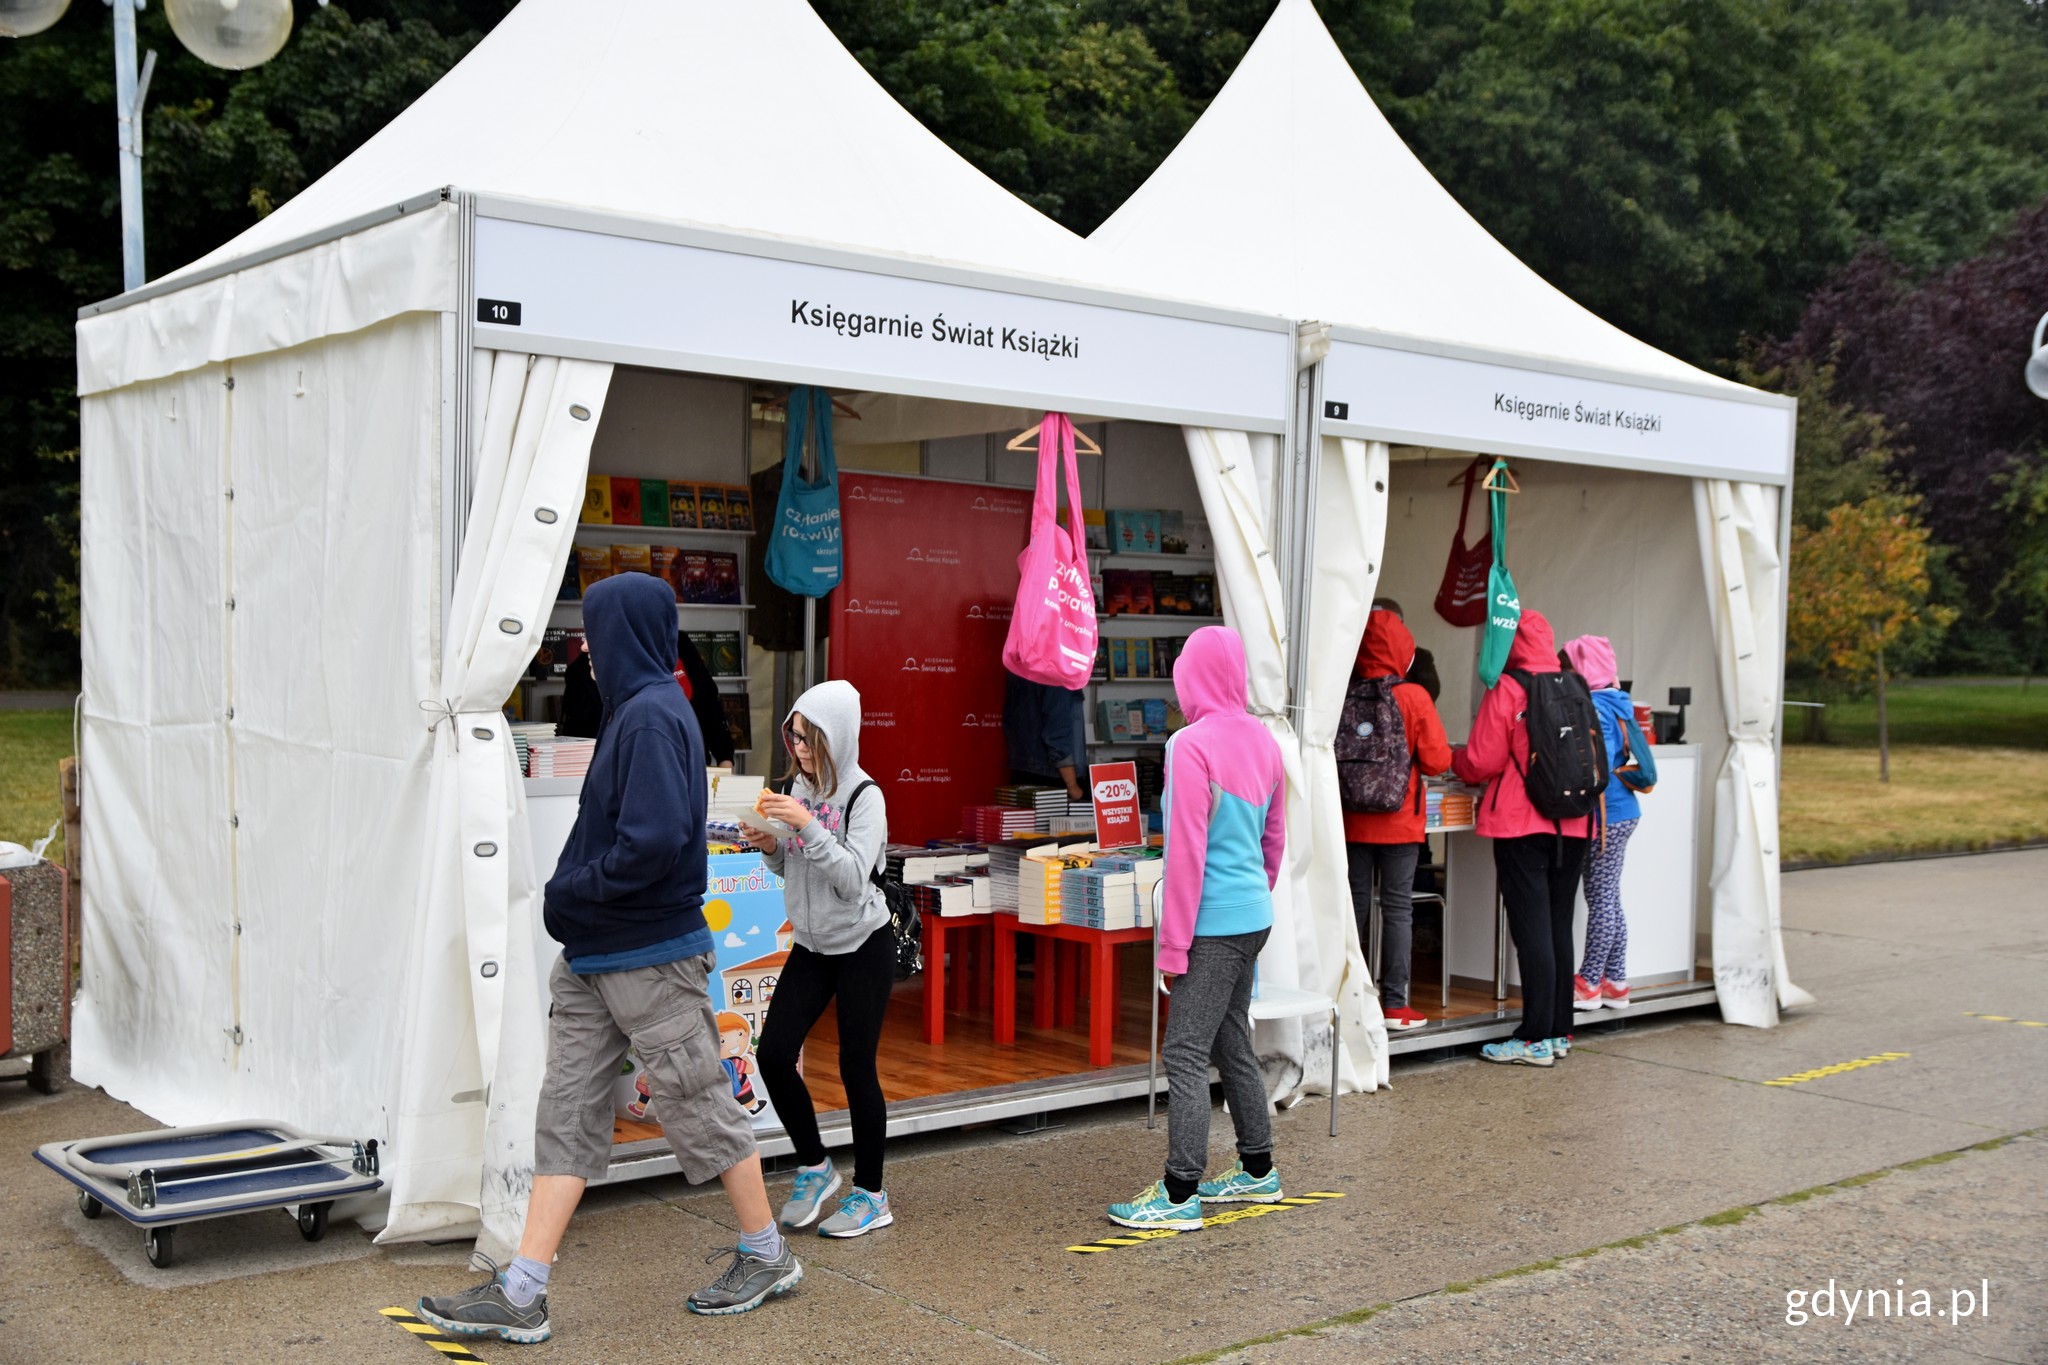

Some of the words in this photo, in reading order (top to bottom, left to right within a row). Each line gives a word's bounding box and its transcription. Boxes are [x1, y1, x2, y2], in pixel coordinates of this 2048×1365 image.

[491, 304, 509, 320] 10
[790, 299, 924, 338] Księgarnie
[931, 312, 994, 348] Świat
[1001, 326, 1080, 361] Książki
[1333, 405, 1341, 416] 9
[1494, 392, 1571, 421] Księgarnie
[1574, 400, 1611, 426] Świat
[1615, 410, 1662, 435] Książki
[1100, 783, 1131, 798] -20%
